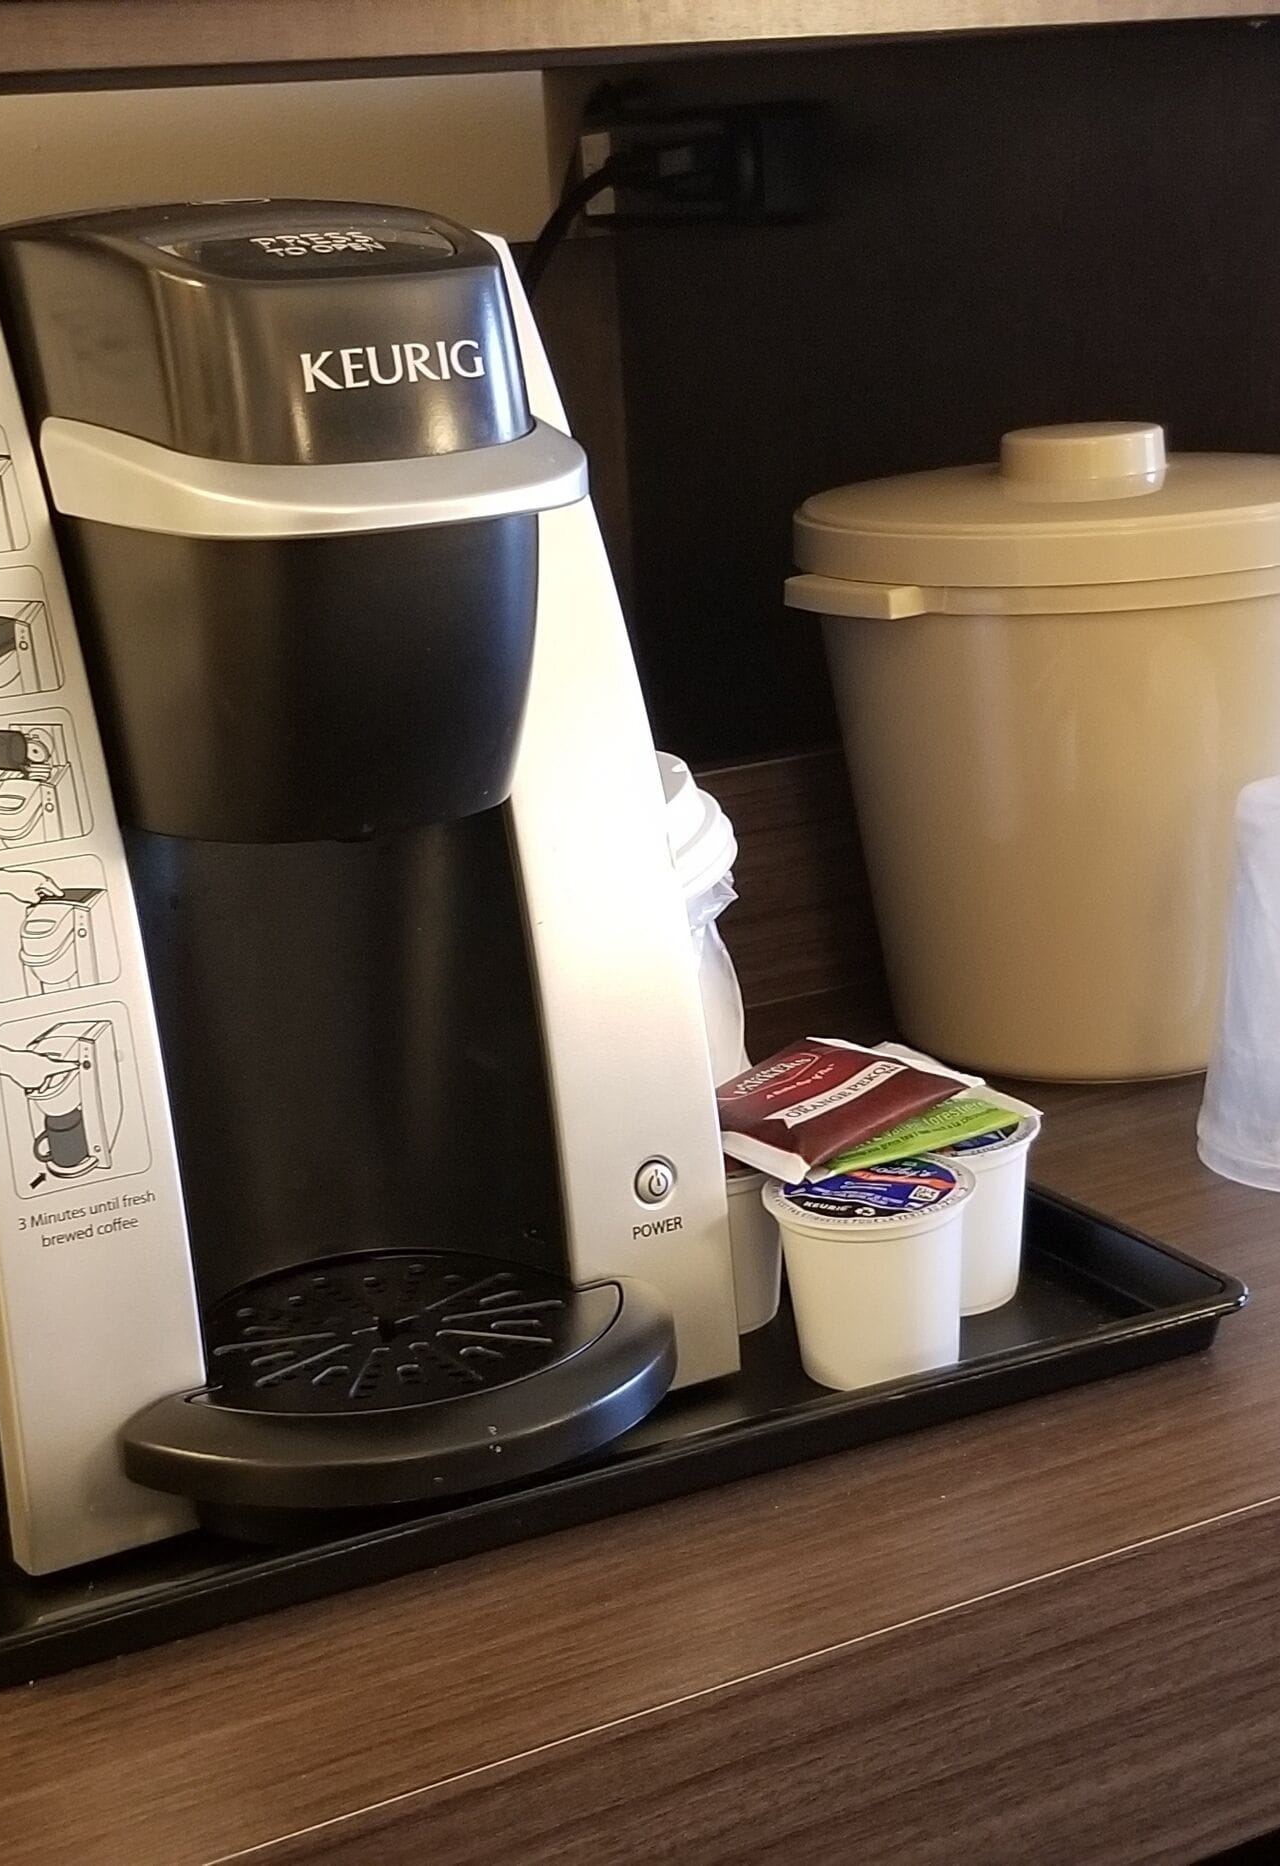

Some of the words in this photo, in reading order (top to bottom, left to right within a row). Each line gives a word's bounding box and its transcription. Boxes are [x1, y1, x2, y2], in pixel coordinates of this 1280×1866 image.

[249, 231, 374, 249] PRESS
[265, 246, 308, 257] TO
[311, 241, 386, 253] OPEN
[299, 339, 486, 393] KEURIG
[785, 1090, 852, 1119] ORANGE
[847, 1063, 900, 1093] PEKOE
[18, 1218, 27, 1230] 3
[30, 1207, 86, 1228] Minutes
[89, 1197, 120, 1215] until
[122, 1190, 156, 1208] fresh
[41, 1224, 94, 1248] brewed
[96, 1217, 139, 1235] coffee
[632, 1216, 683, 1240] POWER
